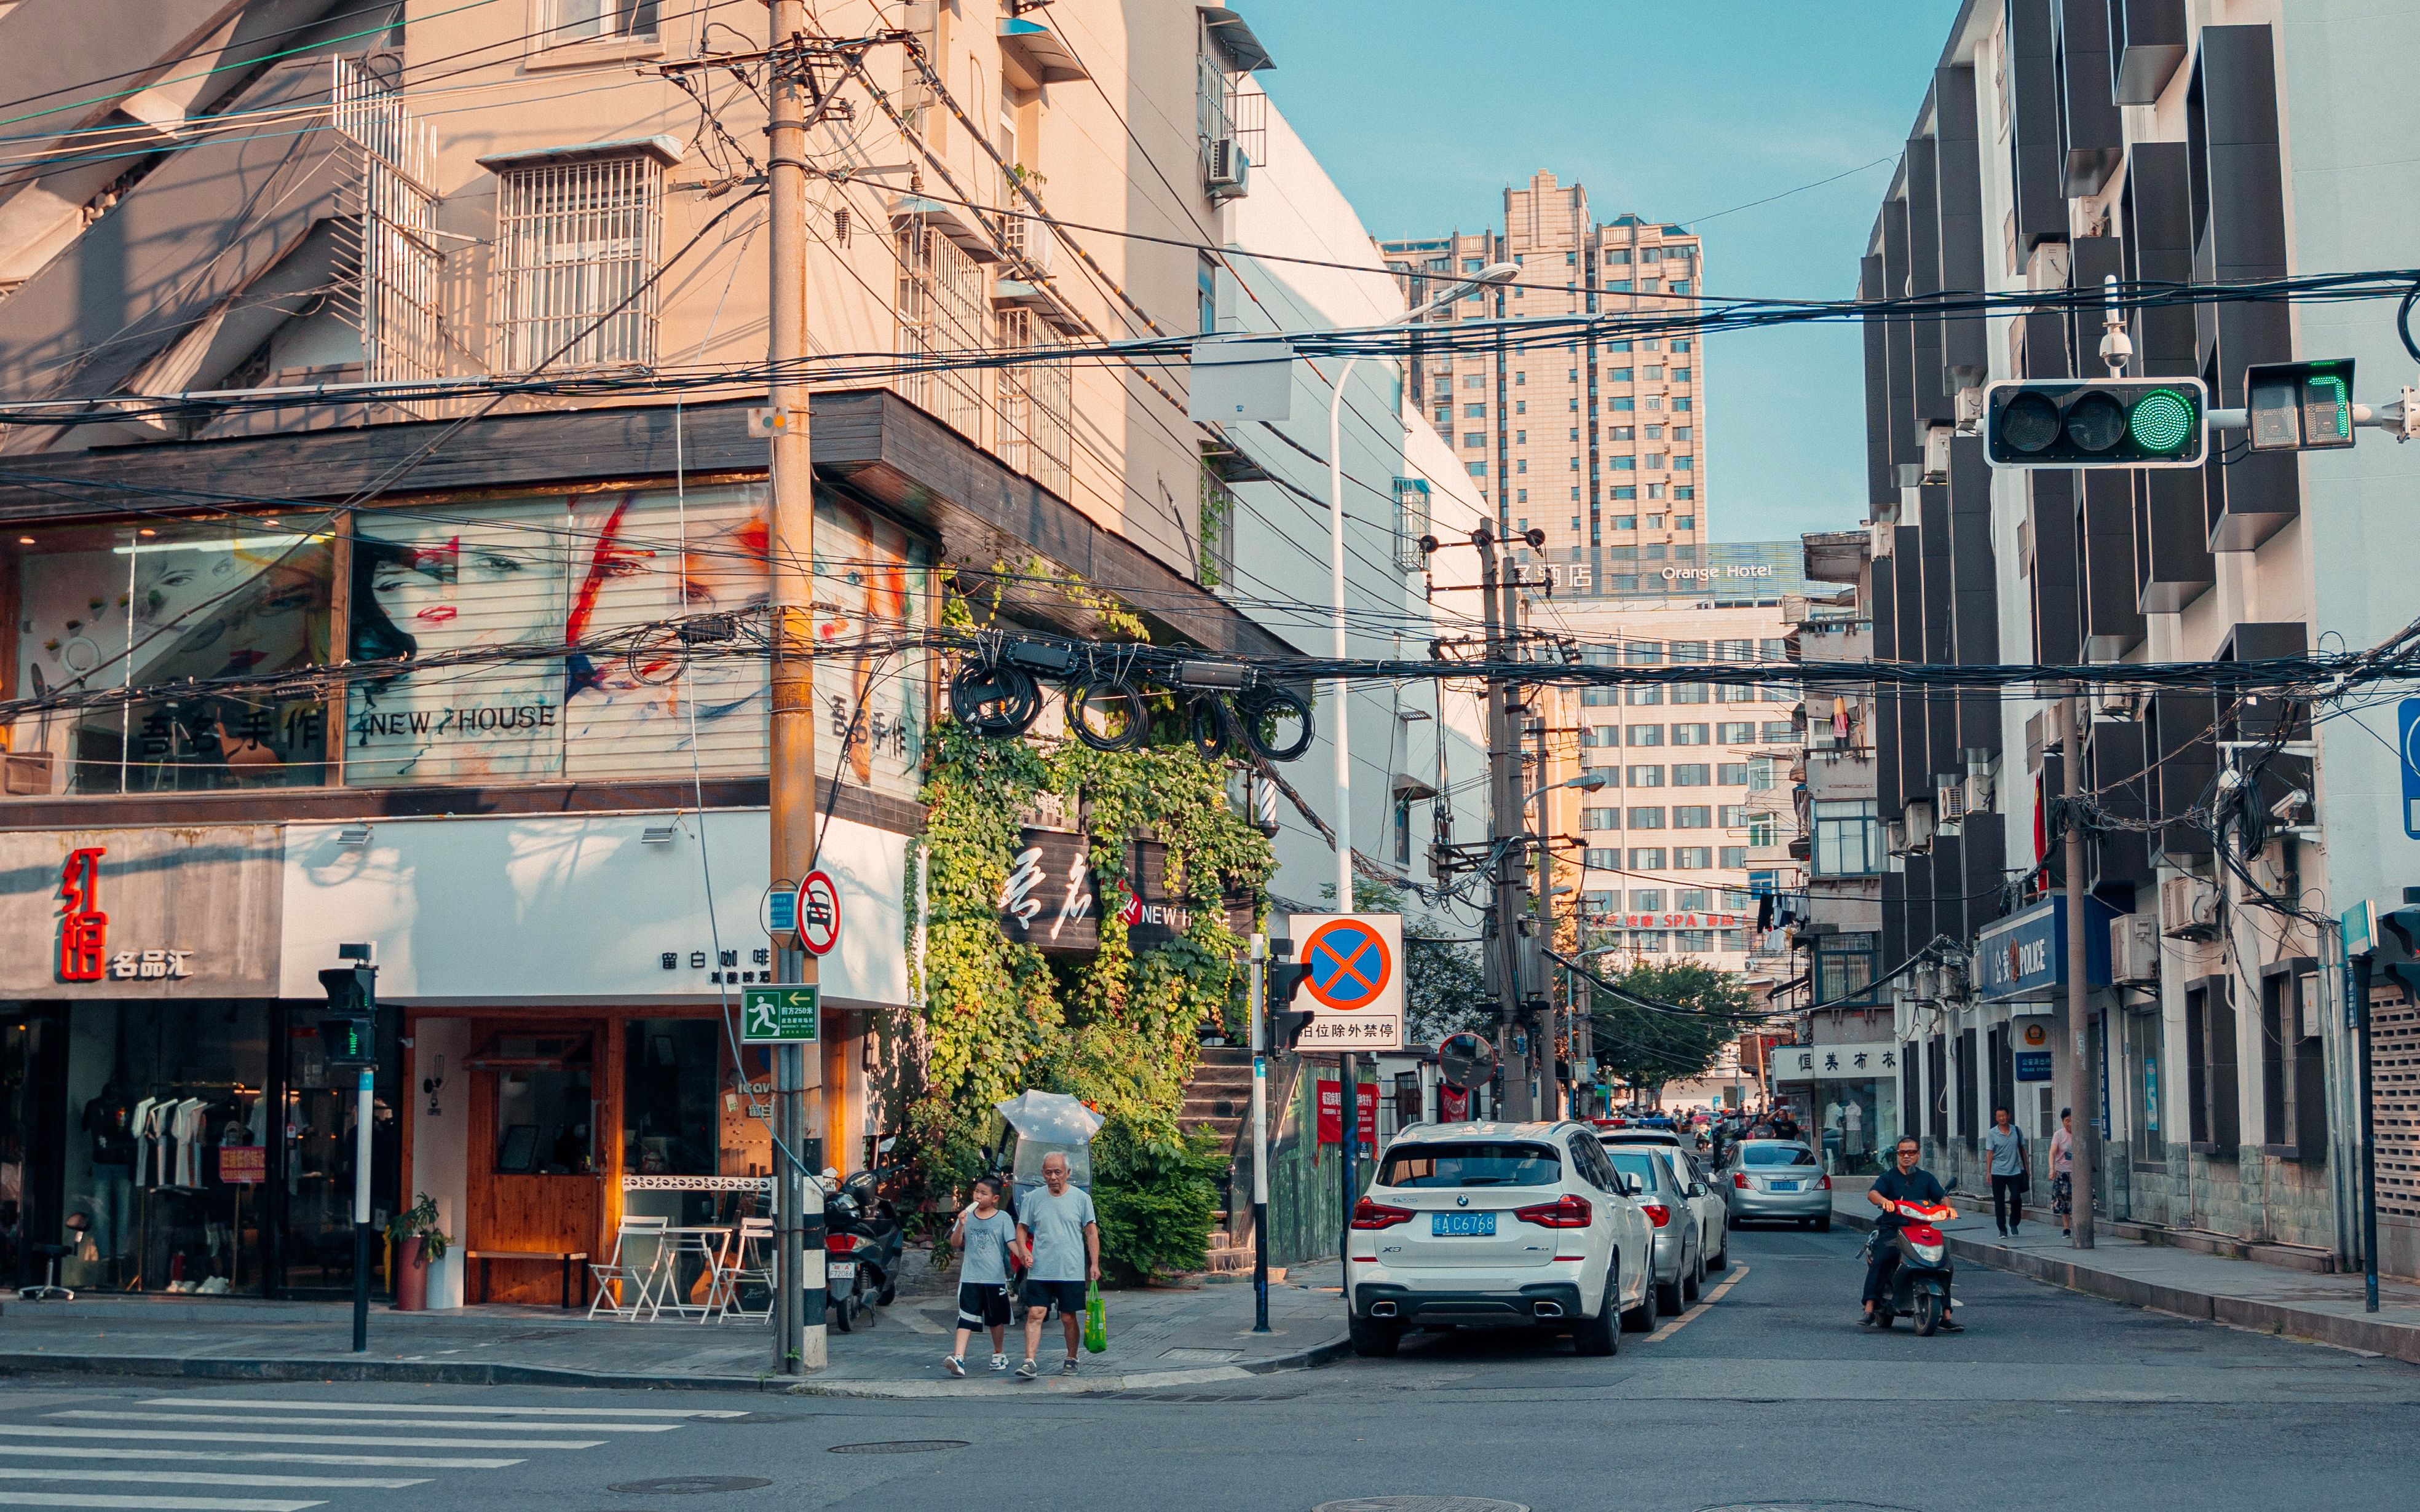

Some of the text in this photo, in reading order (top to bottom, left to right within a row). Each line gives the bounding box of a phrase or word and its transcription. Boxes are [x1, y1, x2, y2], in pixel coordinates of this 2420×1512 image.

[1662, 565, 1771, 581] Orange Hotel
[370, 704, 557, 737] NEW HOUSE
[61, 848, 109, 980] 红馆
[1142, 905, 1177, 926] NEW
[1664, 914, 1697, 927] SPA
[113, 949, 194, 977] 名品汇
[662, 948, 770, 969] 留白咖啡
[1995, 939, 2046, 984] 公安 POLICE
[1798, 1051, 1896, 1071] 恒美布衣
